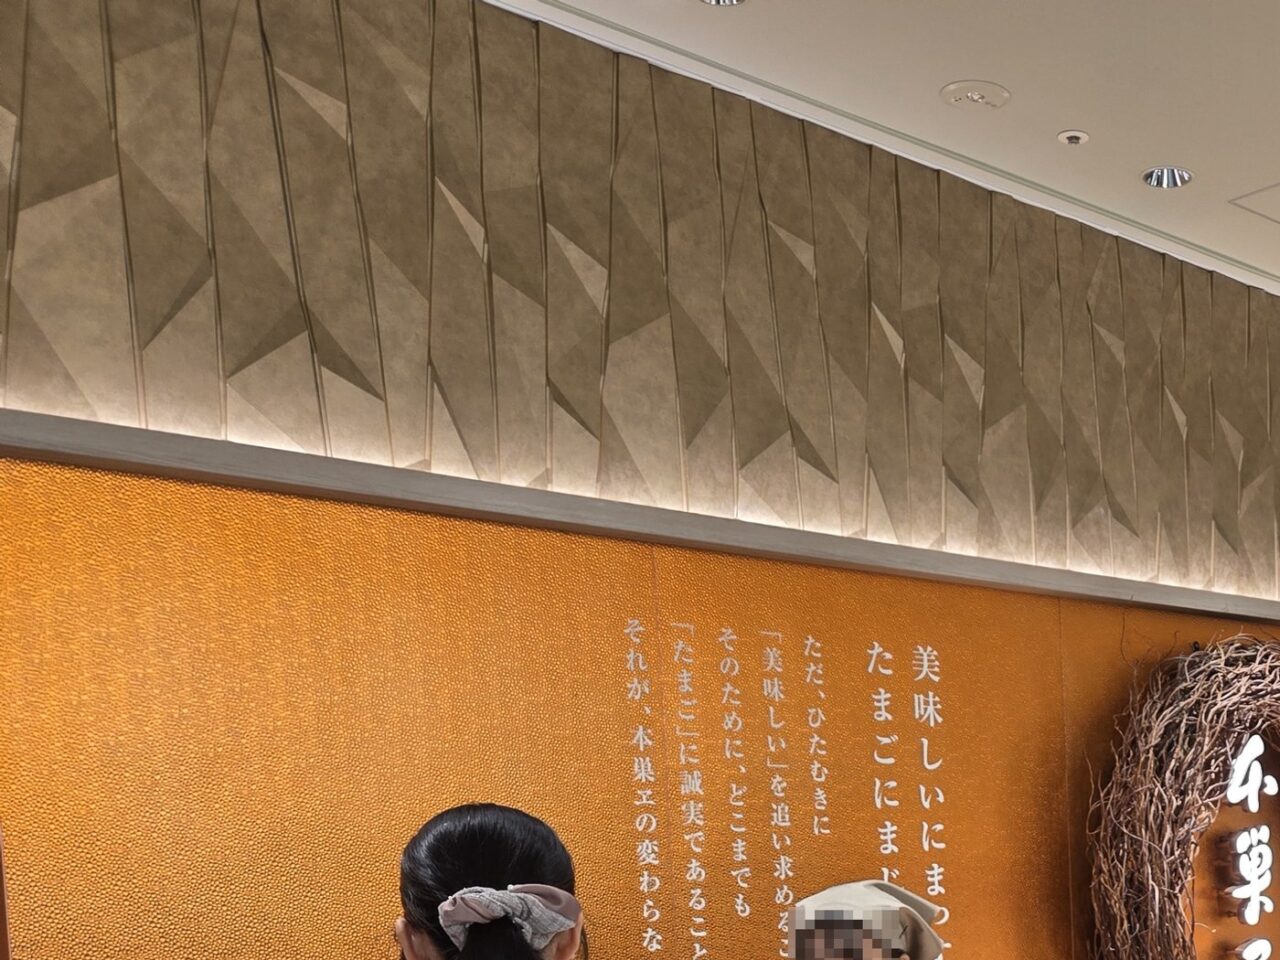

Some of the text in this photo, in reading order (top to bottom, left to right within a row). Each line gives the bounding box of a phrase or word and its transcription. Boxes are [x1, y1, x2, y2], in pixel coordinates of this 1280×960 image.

[718, 626, 751, 917] そのために、どこまでも
[804, 634, 831, 836] ただ、ひたむきに
